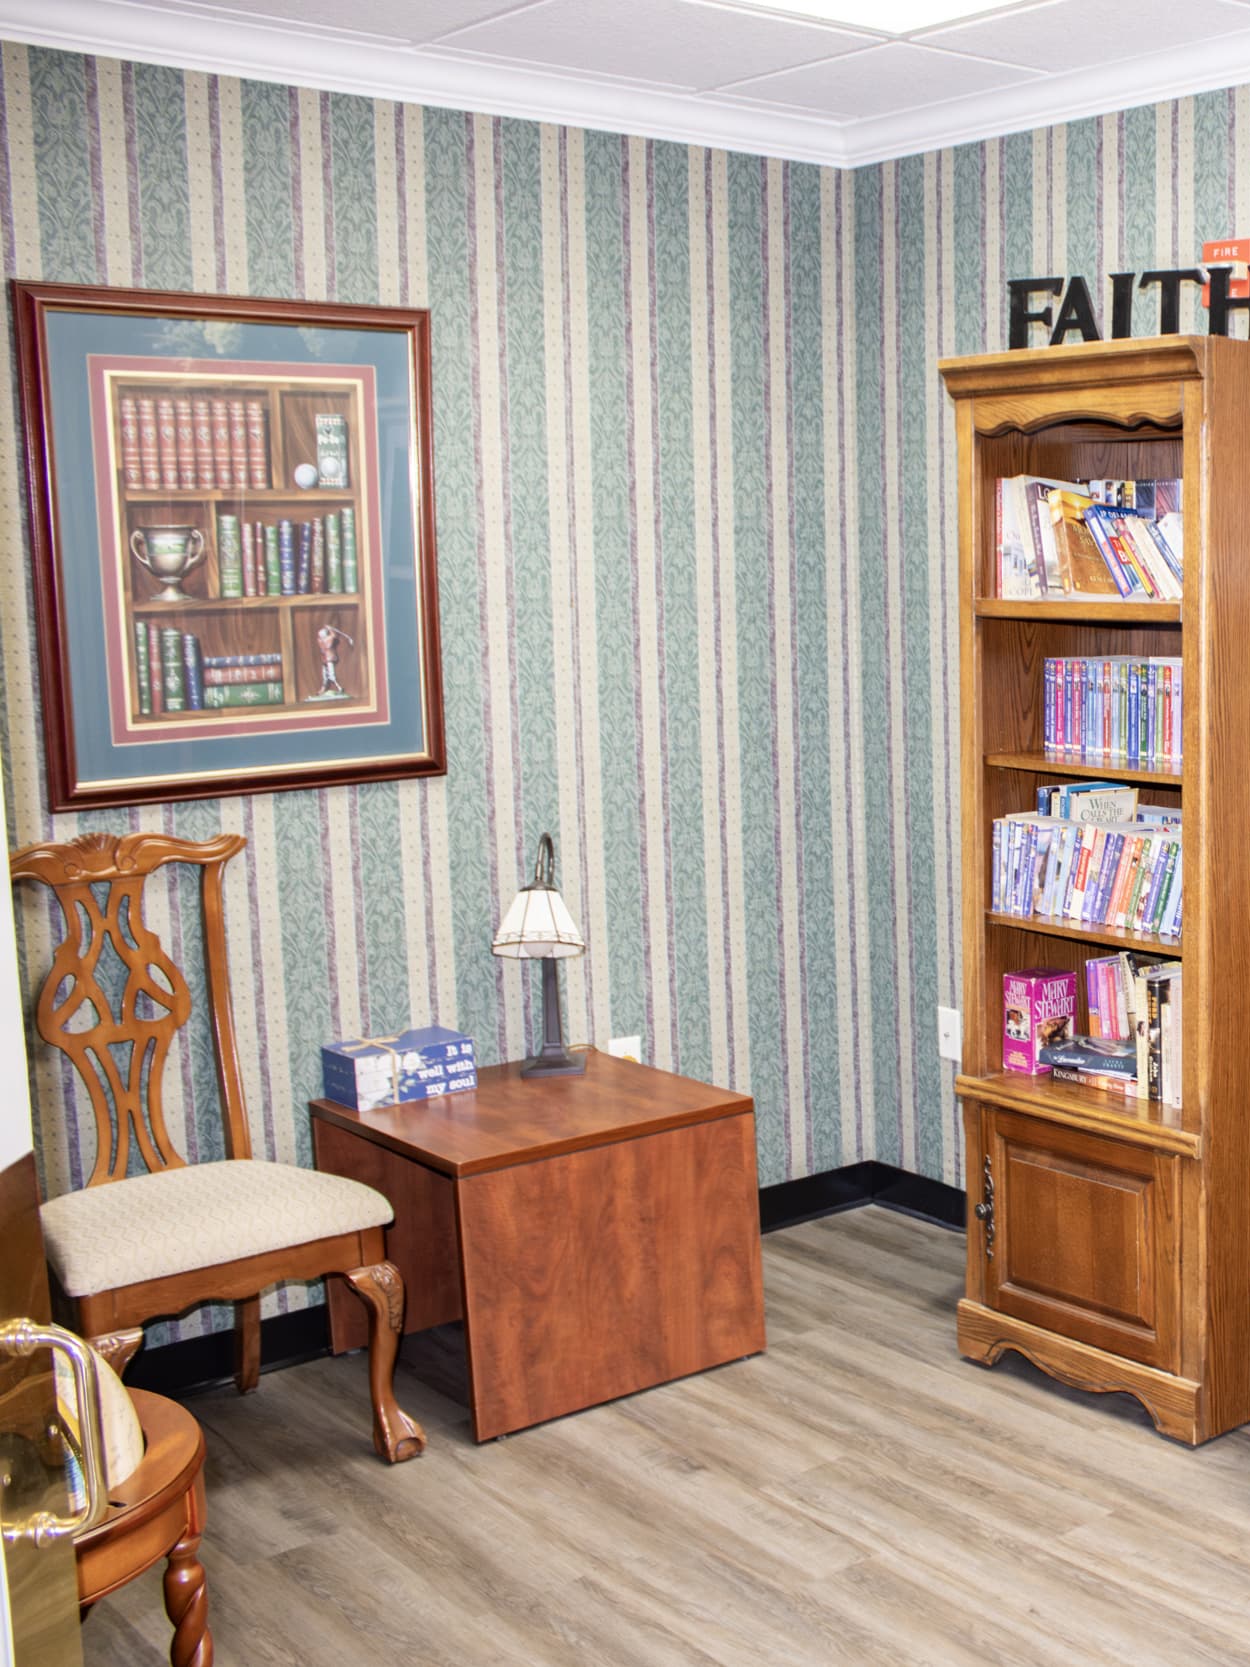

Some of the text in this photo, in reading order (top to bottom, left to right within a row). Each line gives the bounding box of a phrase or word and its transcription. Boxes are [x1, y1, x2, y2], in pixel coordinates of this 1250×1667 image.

[1213, 246, 1239, 258] FIRE
[1089, 798, 1116, 809] WHEN
[1081, 808, 1124, 821] CALLS THE
[1042, 979, 1068, 1001] MARY
[1034, 995, 1074, 1020] STEWART
[446, 1043, 472, 1057] It is
[417, 1059, 474, 1079] well with
[1053, 1068, 1087, 1083] KINGSBURY
[425, 1075, 475, 1096] my soul
